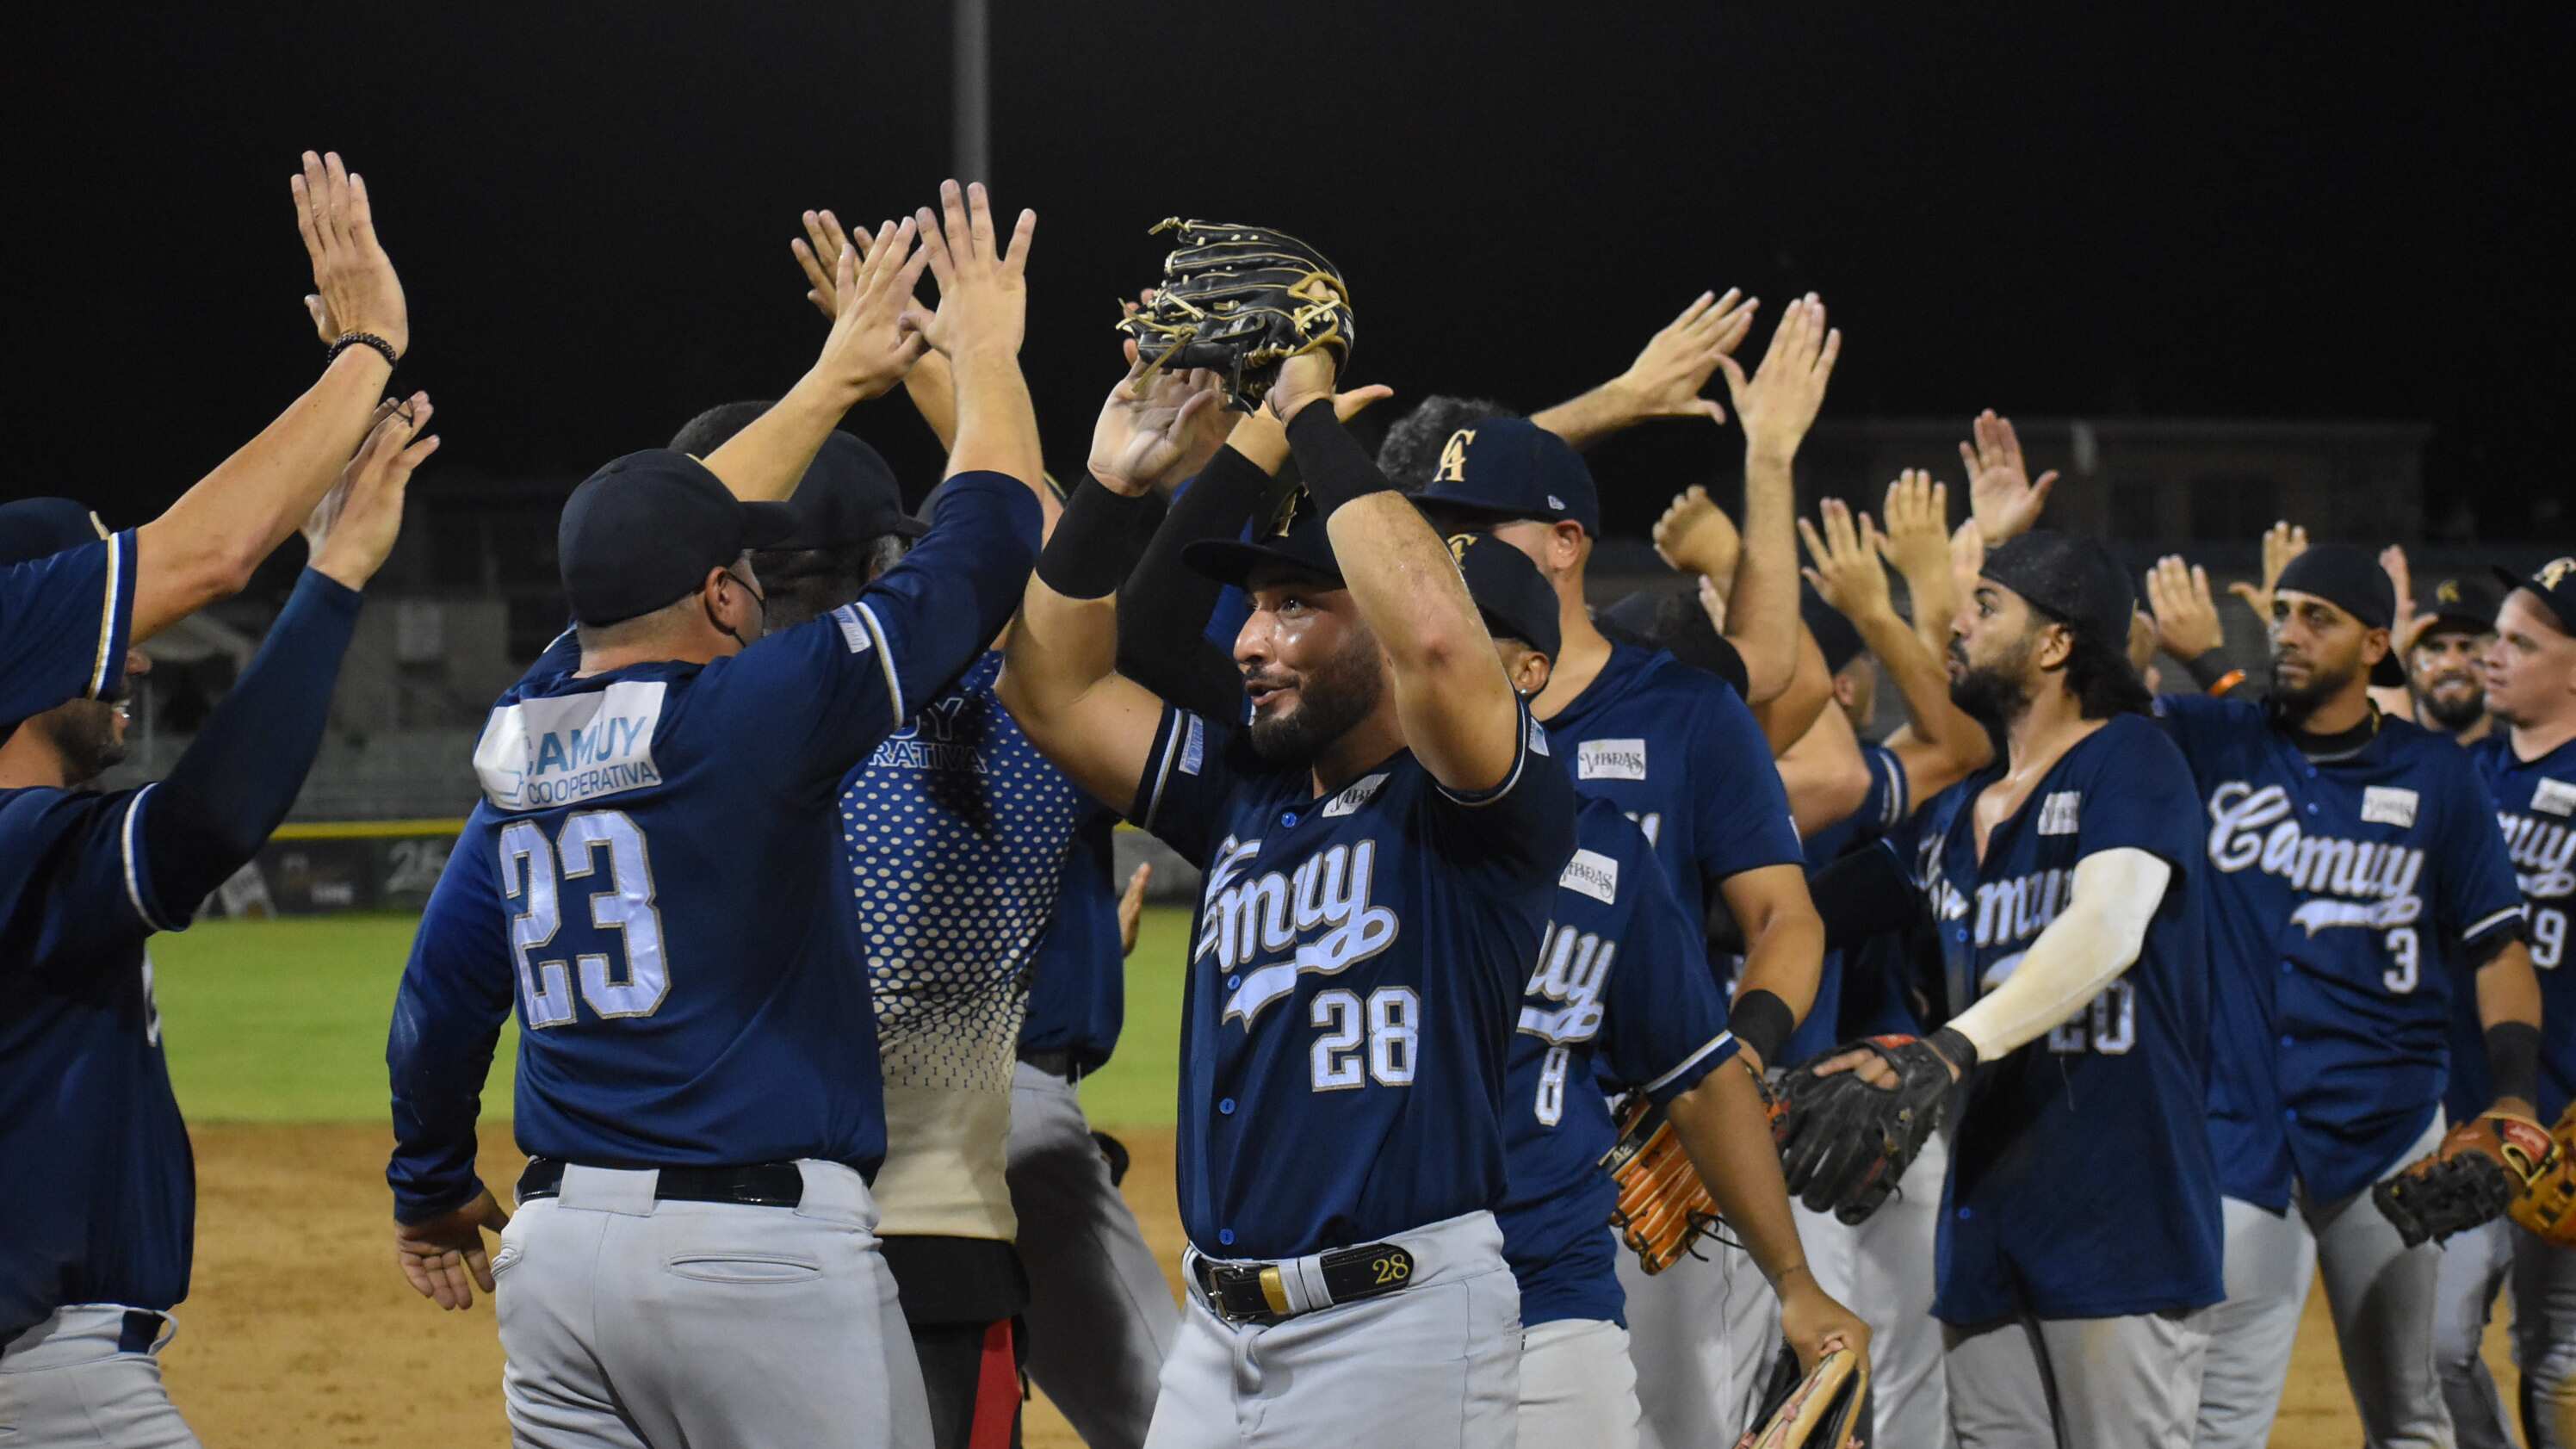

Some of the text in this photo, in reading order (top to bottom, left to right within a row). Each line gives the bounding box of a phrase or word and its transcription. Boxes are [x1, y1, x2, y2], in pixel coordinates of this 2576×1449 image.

[526, 761, 659, 806] COOPERATIVA
[2208, 780, 2425, 942] Camuy
[498, 809, 672, 1030] 23
[2522, 903, 2567, 969] 9
[2382, 926, 2420, 994] 3
[1309, 985, 1421, 1093] 28
[1533, 1045, 1571, 1127] 8
[1372, 1253, 1410, 1285] 28
